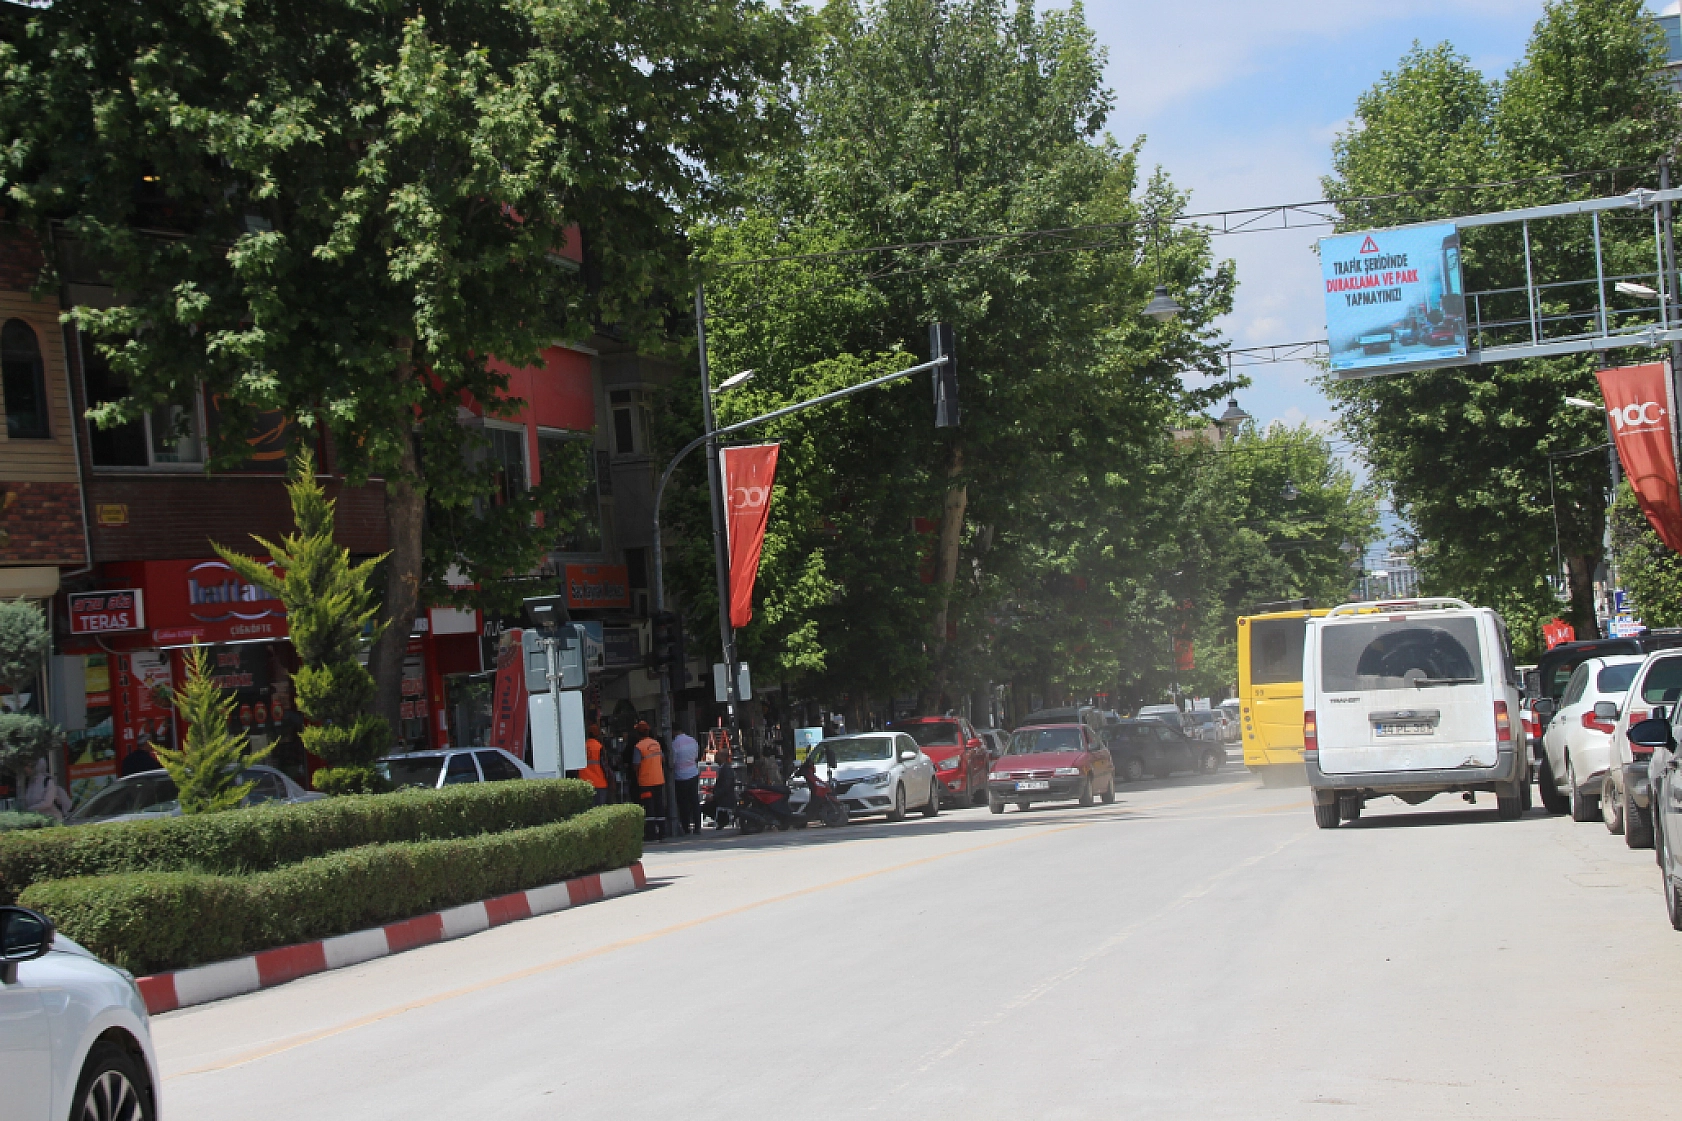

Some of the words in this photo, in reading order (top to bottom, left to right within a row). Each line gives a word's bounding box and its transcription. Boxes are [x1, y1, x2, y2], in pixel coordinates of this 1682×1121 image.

[1326, 275, 1380, 293] DURAKLAMA
[1382, 272, 1394, 286] VE
[1395, 269, 1419, 284] PARK
[80, 612, 129, 630] TERAS
